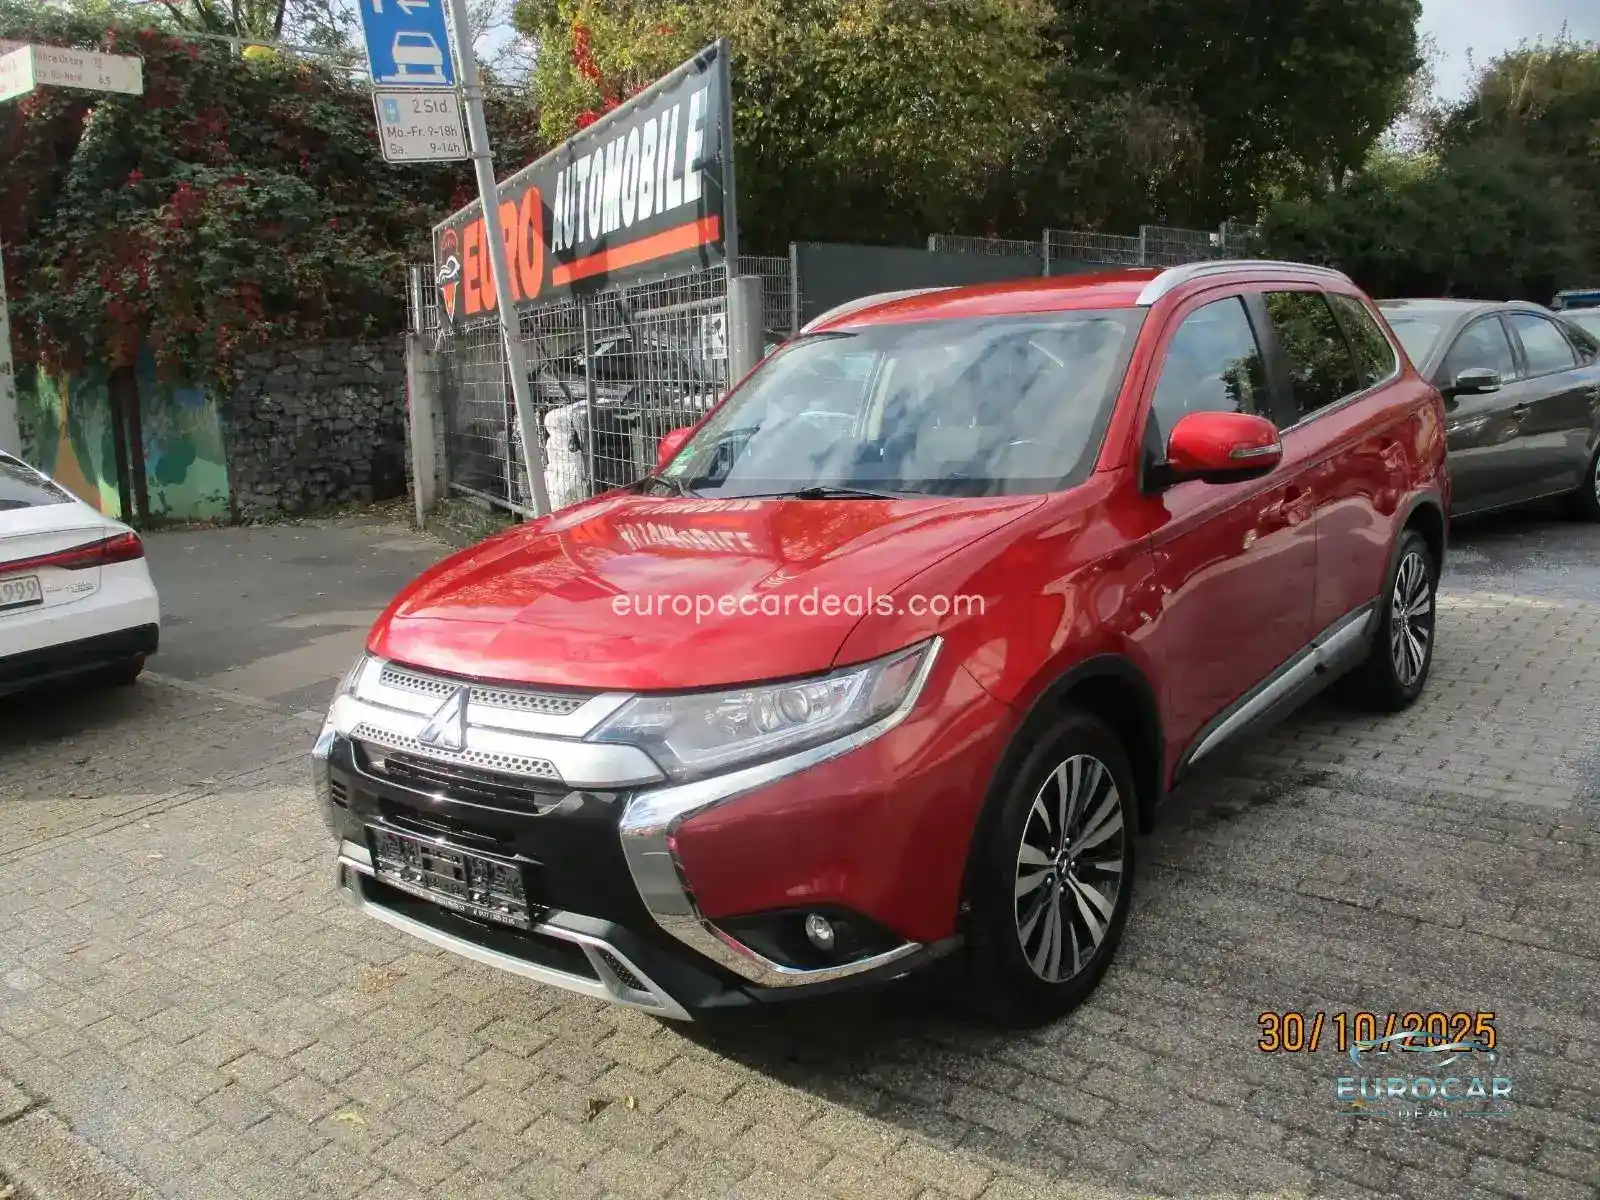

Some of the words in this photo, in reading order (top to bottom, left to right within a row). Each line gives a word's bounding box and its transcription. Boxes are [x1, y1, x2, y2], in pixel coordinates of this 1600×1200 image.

[413, 99, 421, 114] 2
[551, 85, 709, 254] AUTOMOBILE
[463, 185, 544, 315] EURO
